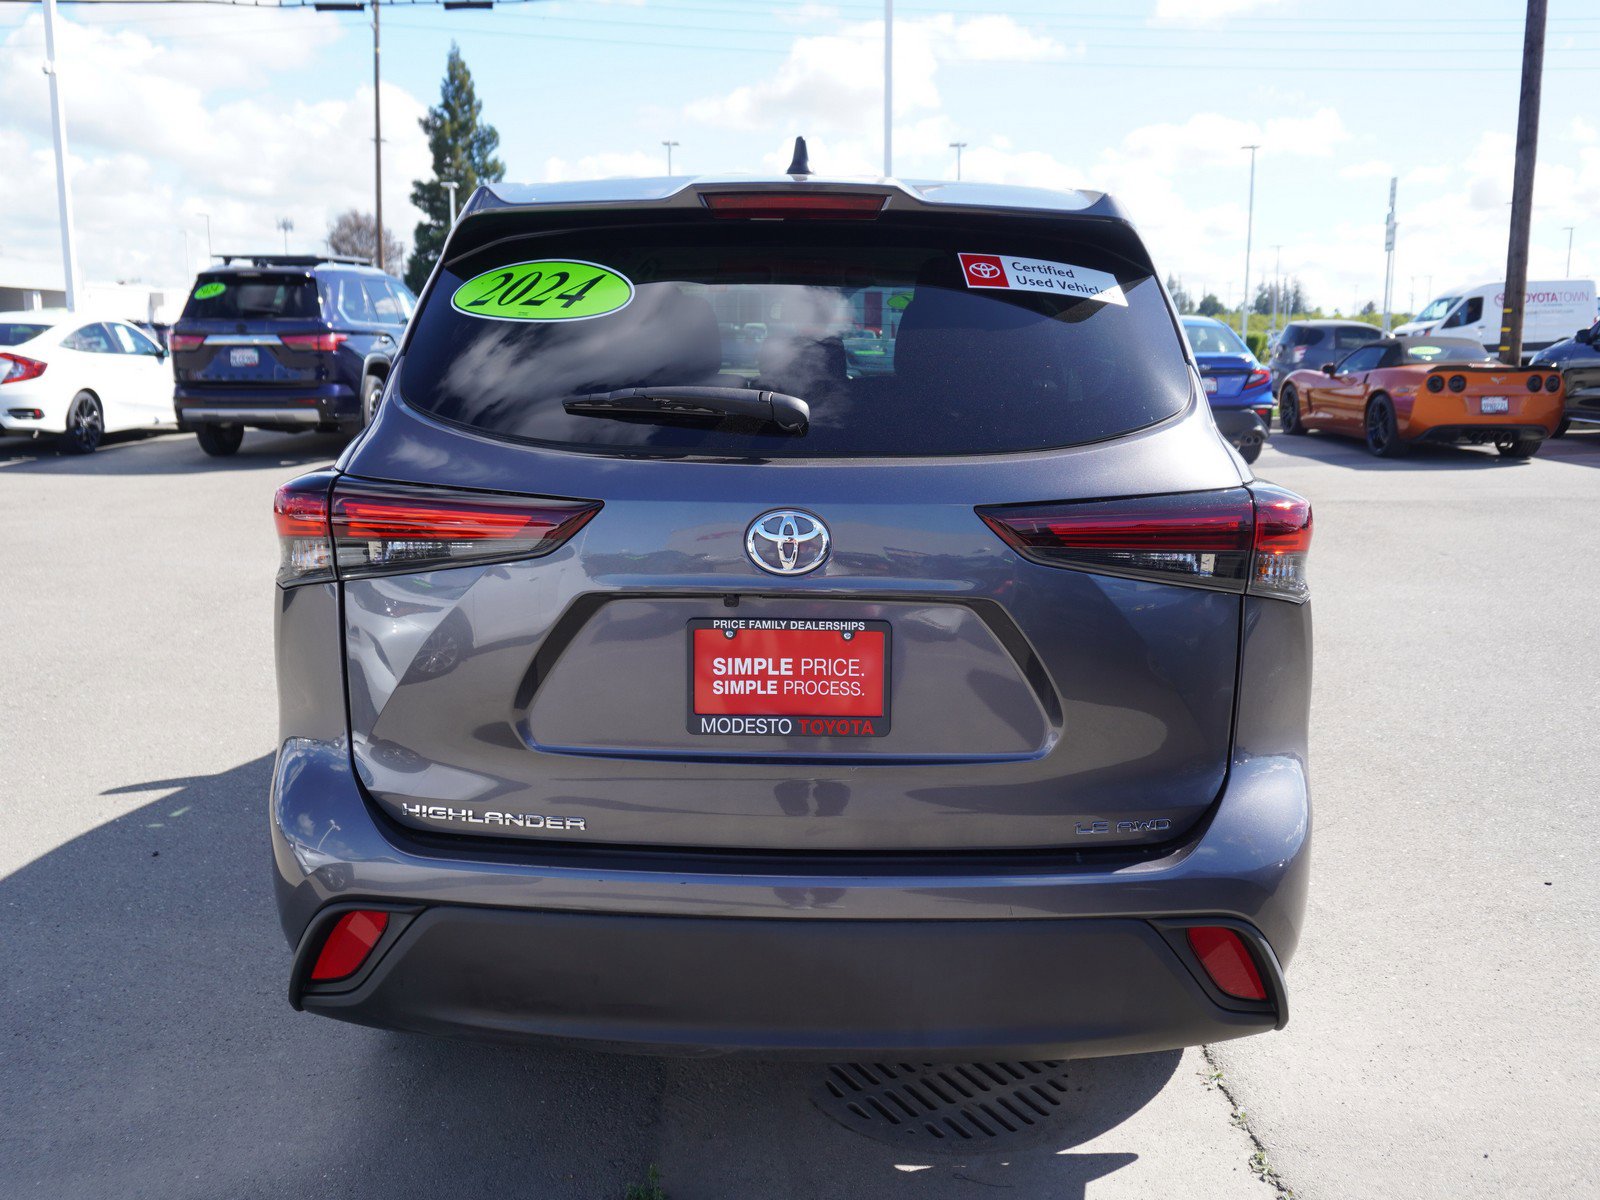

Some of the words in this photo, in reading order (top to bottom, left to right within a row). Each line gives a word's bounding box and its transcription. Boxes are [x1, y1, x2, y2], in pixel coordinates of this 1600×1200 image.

[1012, 262, 1075, 278] Certified
[465, 271, 607, 308] 2024
[1016, 275, 1054, 288] Used
[713, 620, 746, 629] PRICE
[749, 620, 787, 630] FAMILY
[790, 621, 866, 631] DEALERSHIPS
[712, 657, 793, 676] SIMPLE
[800, 658, 865, 677] PRICE.
[712, 680, 778, 694] SIMPLE
[783, 681, 865, 696] PROCESS.
[701, 717, 792, 734] MODESTO
[799, 719, 875, 735] TOYOTA
[402, 803, 586, 830] HIGHLANDER
[1075, 820, 1109, 835] LE
[1116, 818, 1172, 833] AWD
